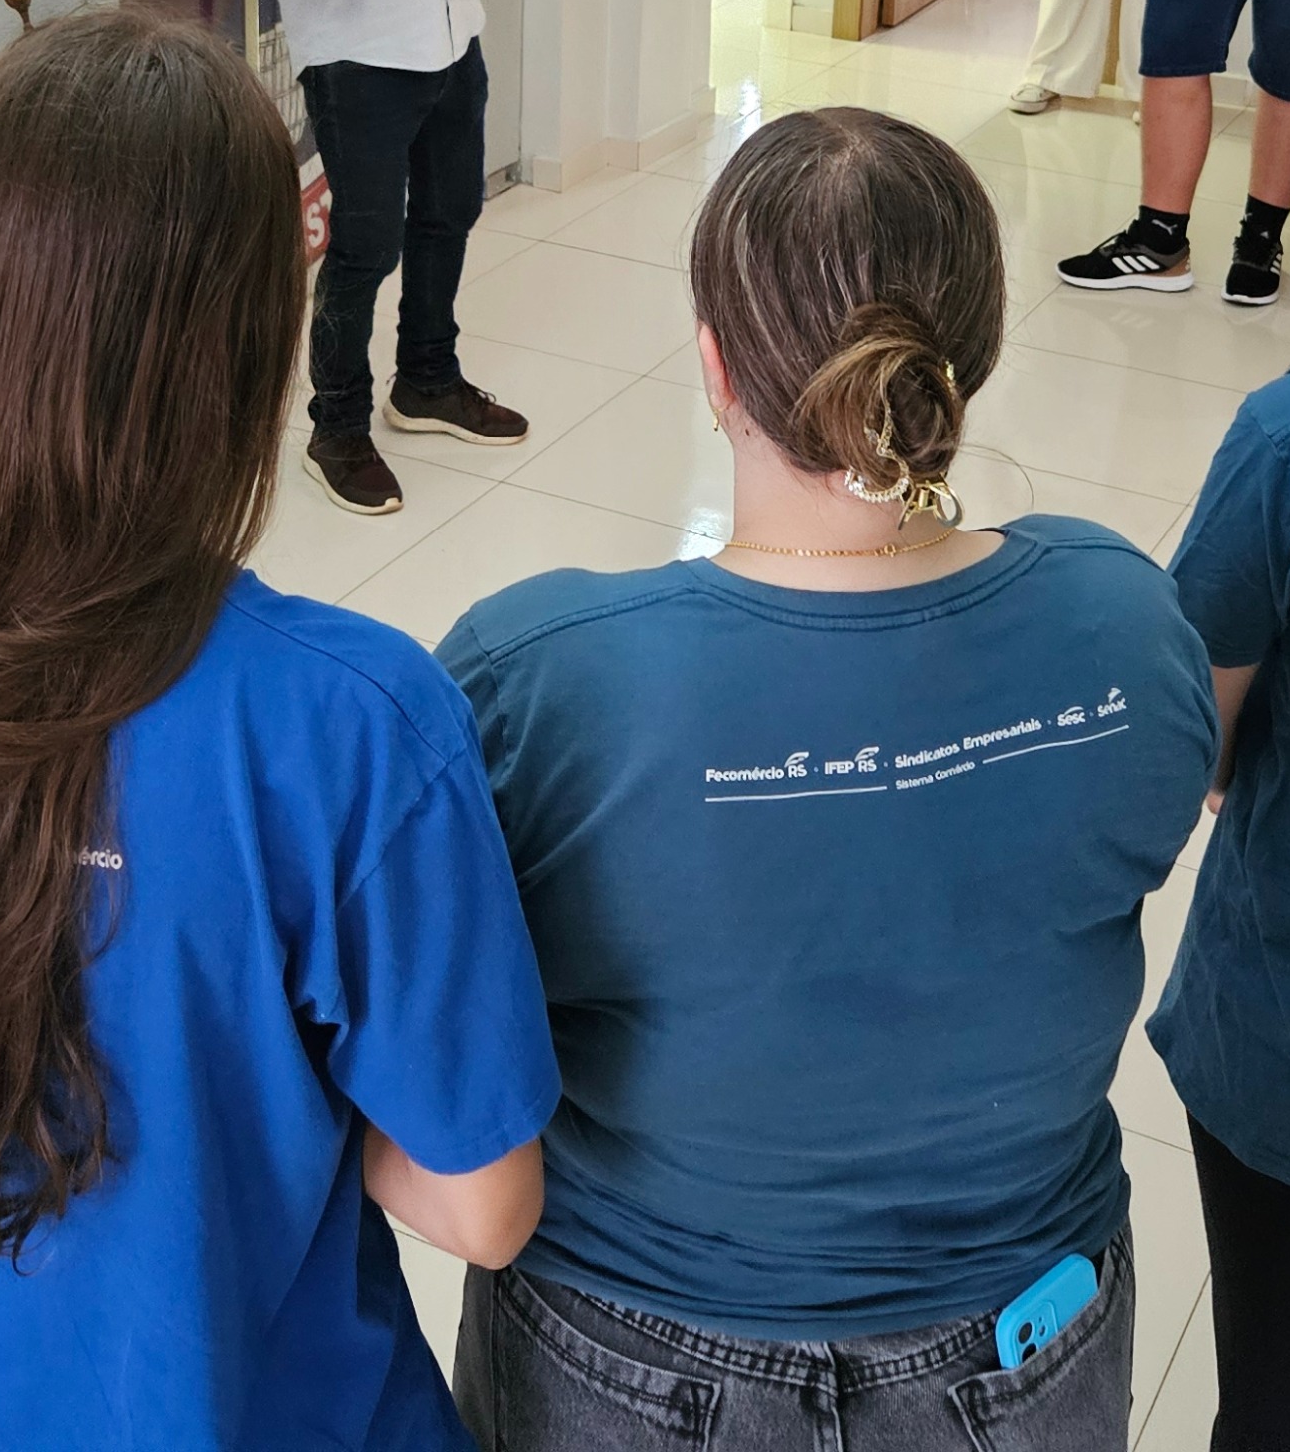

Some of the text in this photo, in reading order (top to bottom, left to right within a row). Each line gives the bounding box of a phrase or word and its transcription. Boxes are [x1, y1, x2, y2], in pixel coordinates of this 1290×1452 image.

[705, 764, 785, 783] Fecomércio
[824, 761, 855, 776] IFEP
[895, 742, 960, 770] Sindicatos
[962, 718, 1042, 751] Empresariais
[1057, 711, 1086, 727] Sesc
[895, 773, 935, 790] Sistema
